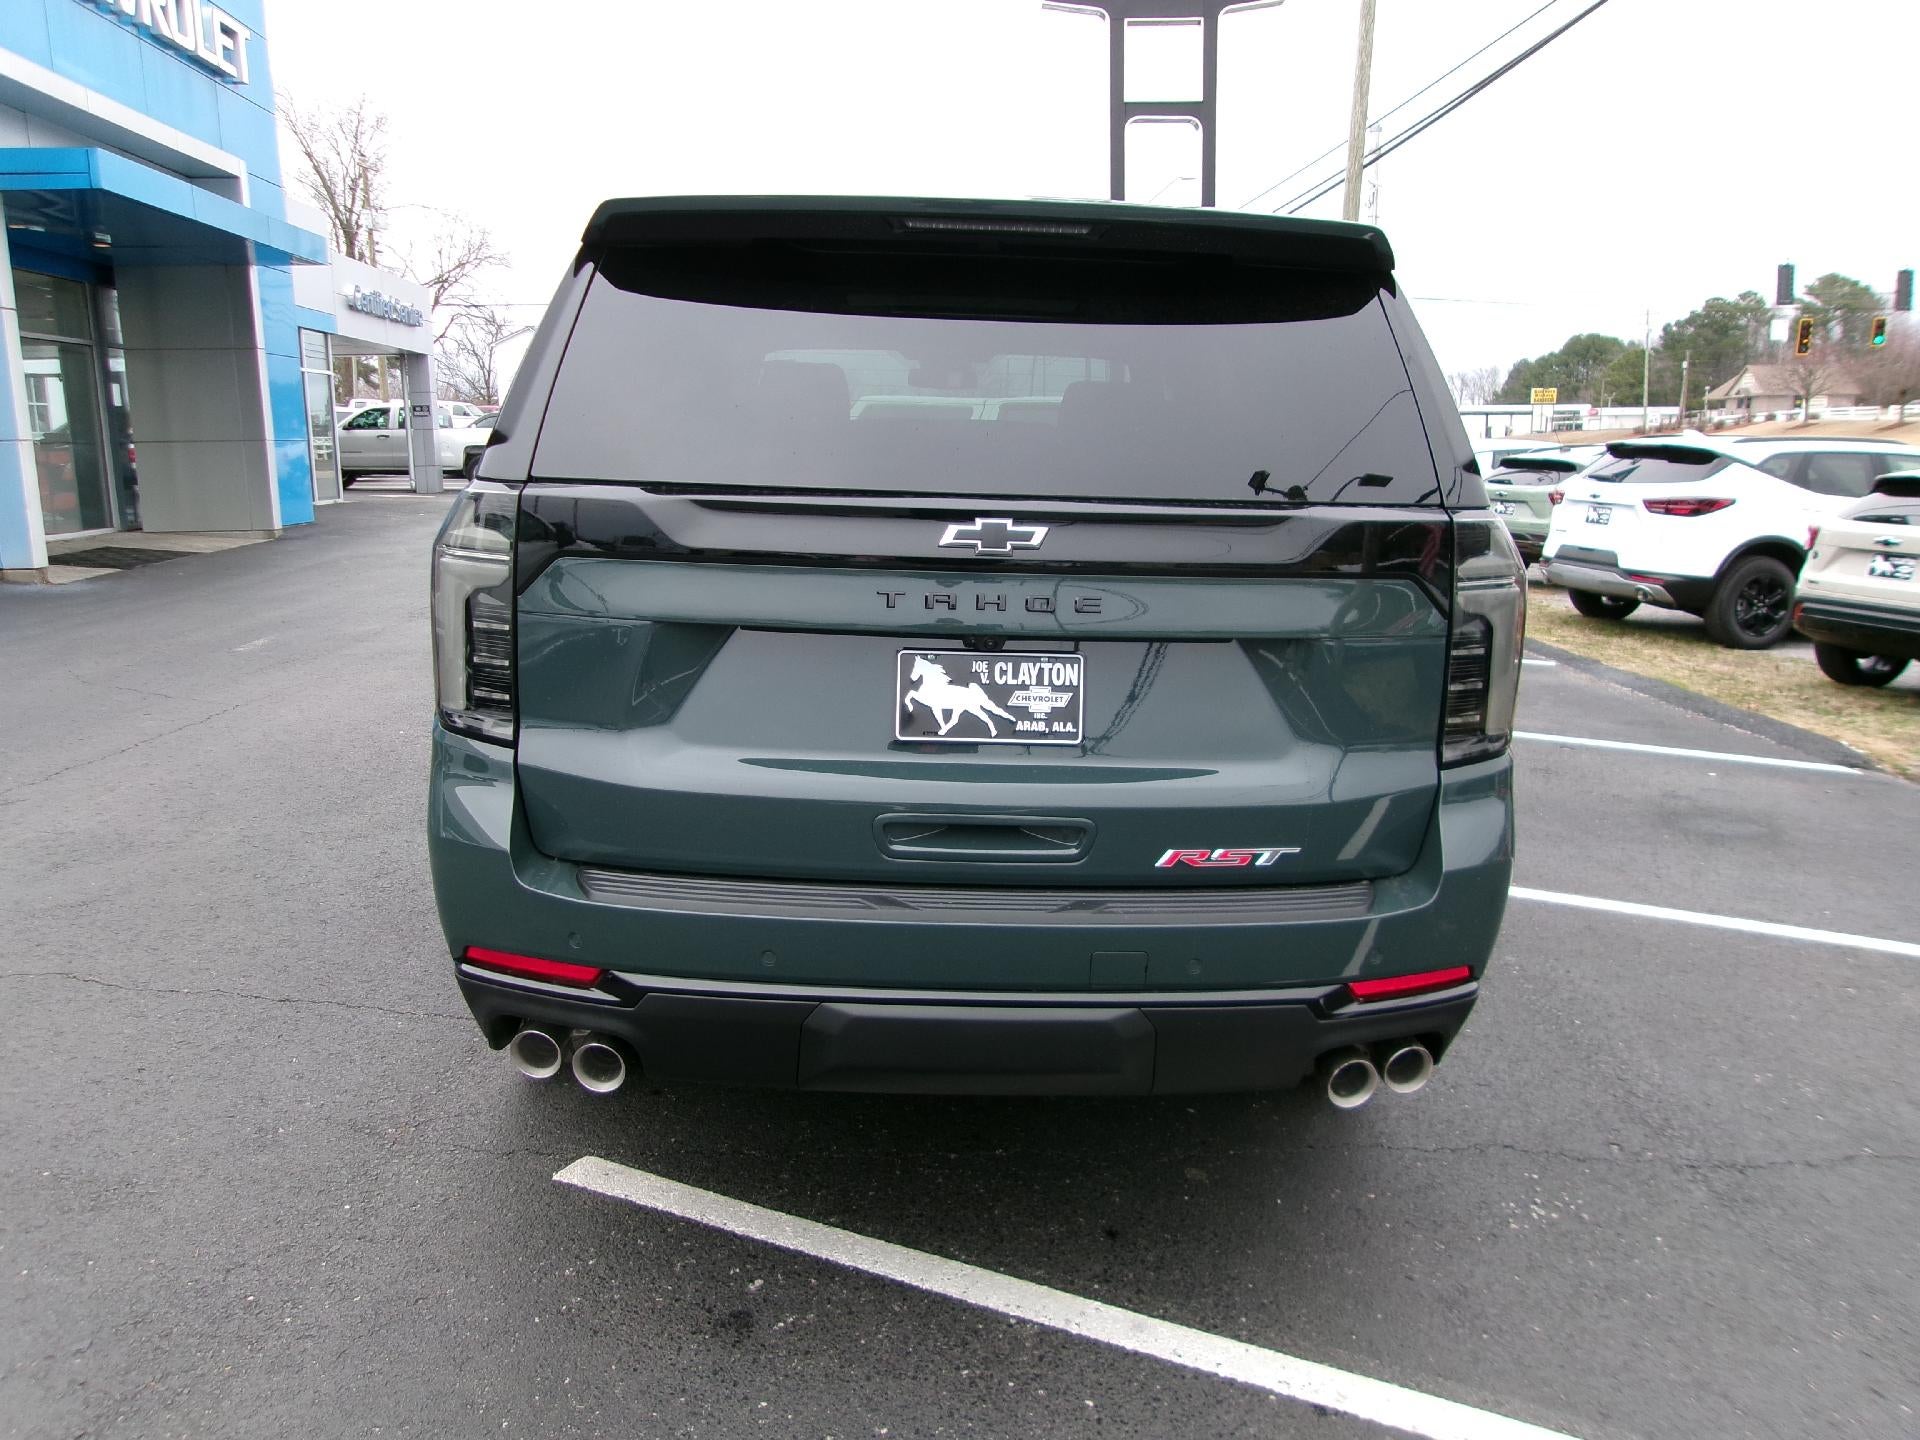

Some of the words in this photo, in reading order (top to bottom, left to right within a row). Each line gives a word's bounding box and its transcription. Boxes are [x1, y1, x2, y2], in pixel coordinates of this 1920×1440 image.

[876, 591, 1102, 614] TAHOE
[971, 660, 989, 673] JOE
[994, 661, 1079, 686] CLAYTON
[1015, 694, 1064, 703] CHEVROLET
[1015, 720, 1049, 734] ARAB,
[1052, 721, 1077, 733] ALA.
[1155, 847, 1302, 868] RST
